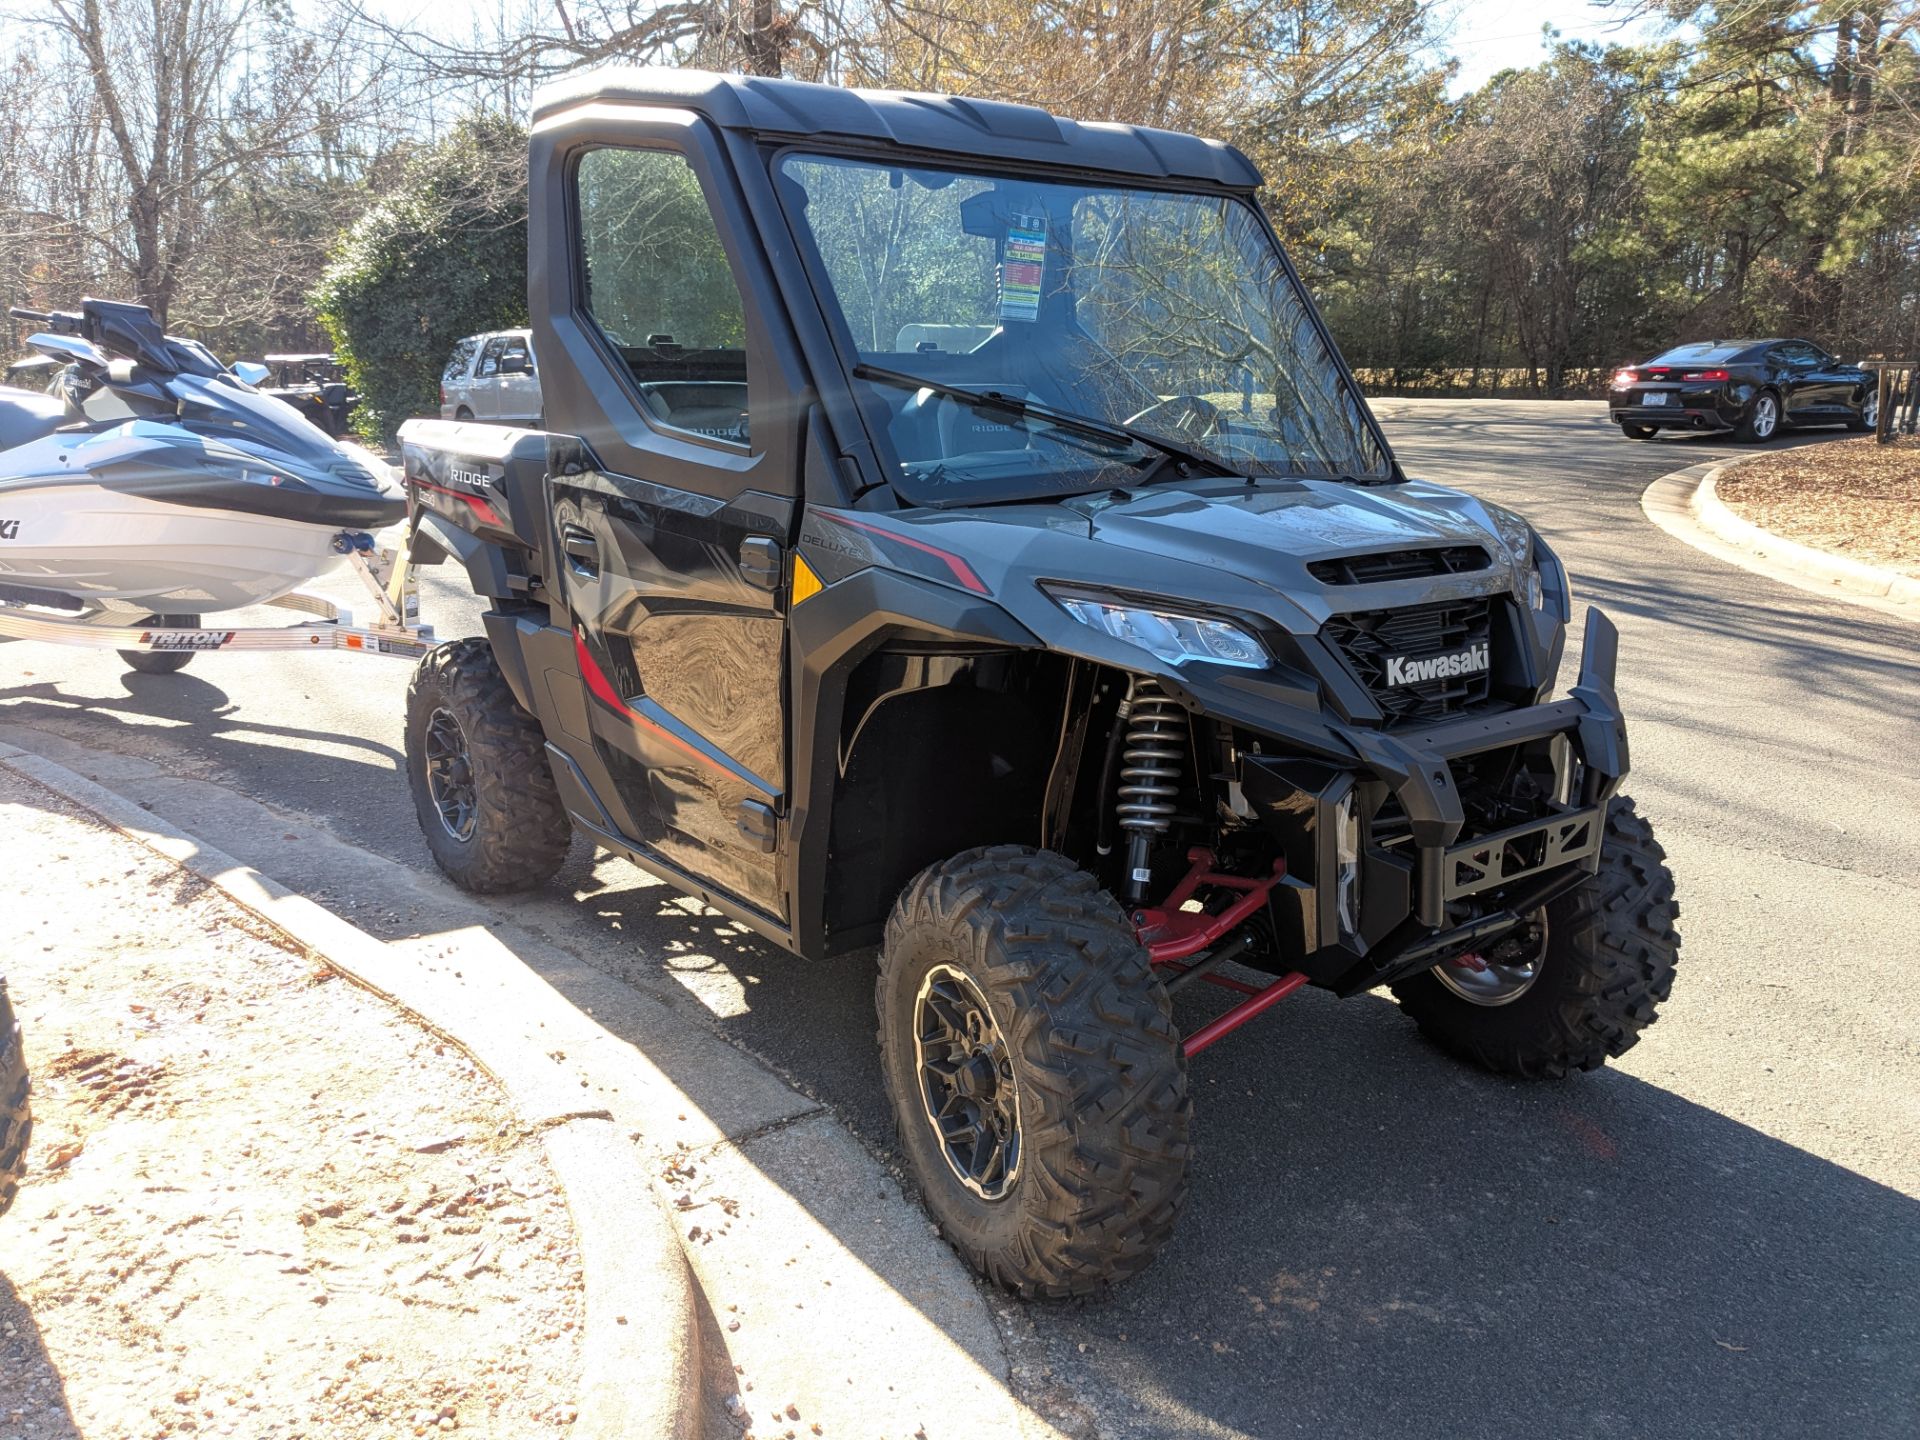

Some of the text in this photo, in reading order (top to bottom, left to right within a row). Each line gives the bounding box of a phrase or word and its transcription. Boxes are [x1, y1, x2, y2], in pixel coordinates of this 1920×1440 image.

[450, 469, 491, 488] RIDGE
[802, 534, 860, 557] DELUXE
[149, 631, 227, 644] TRITON
[1386, 642, 1490, 687] Kawasaki
